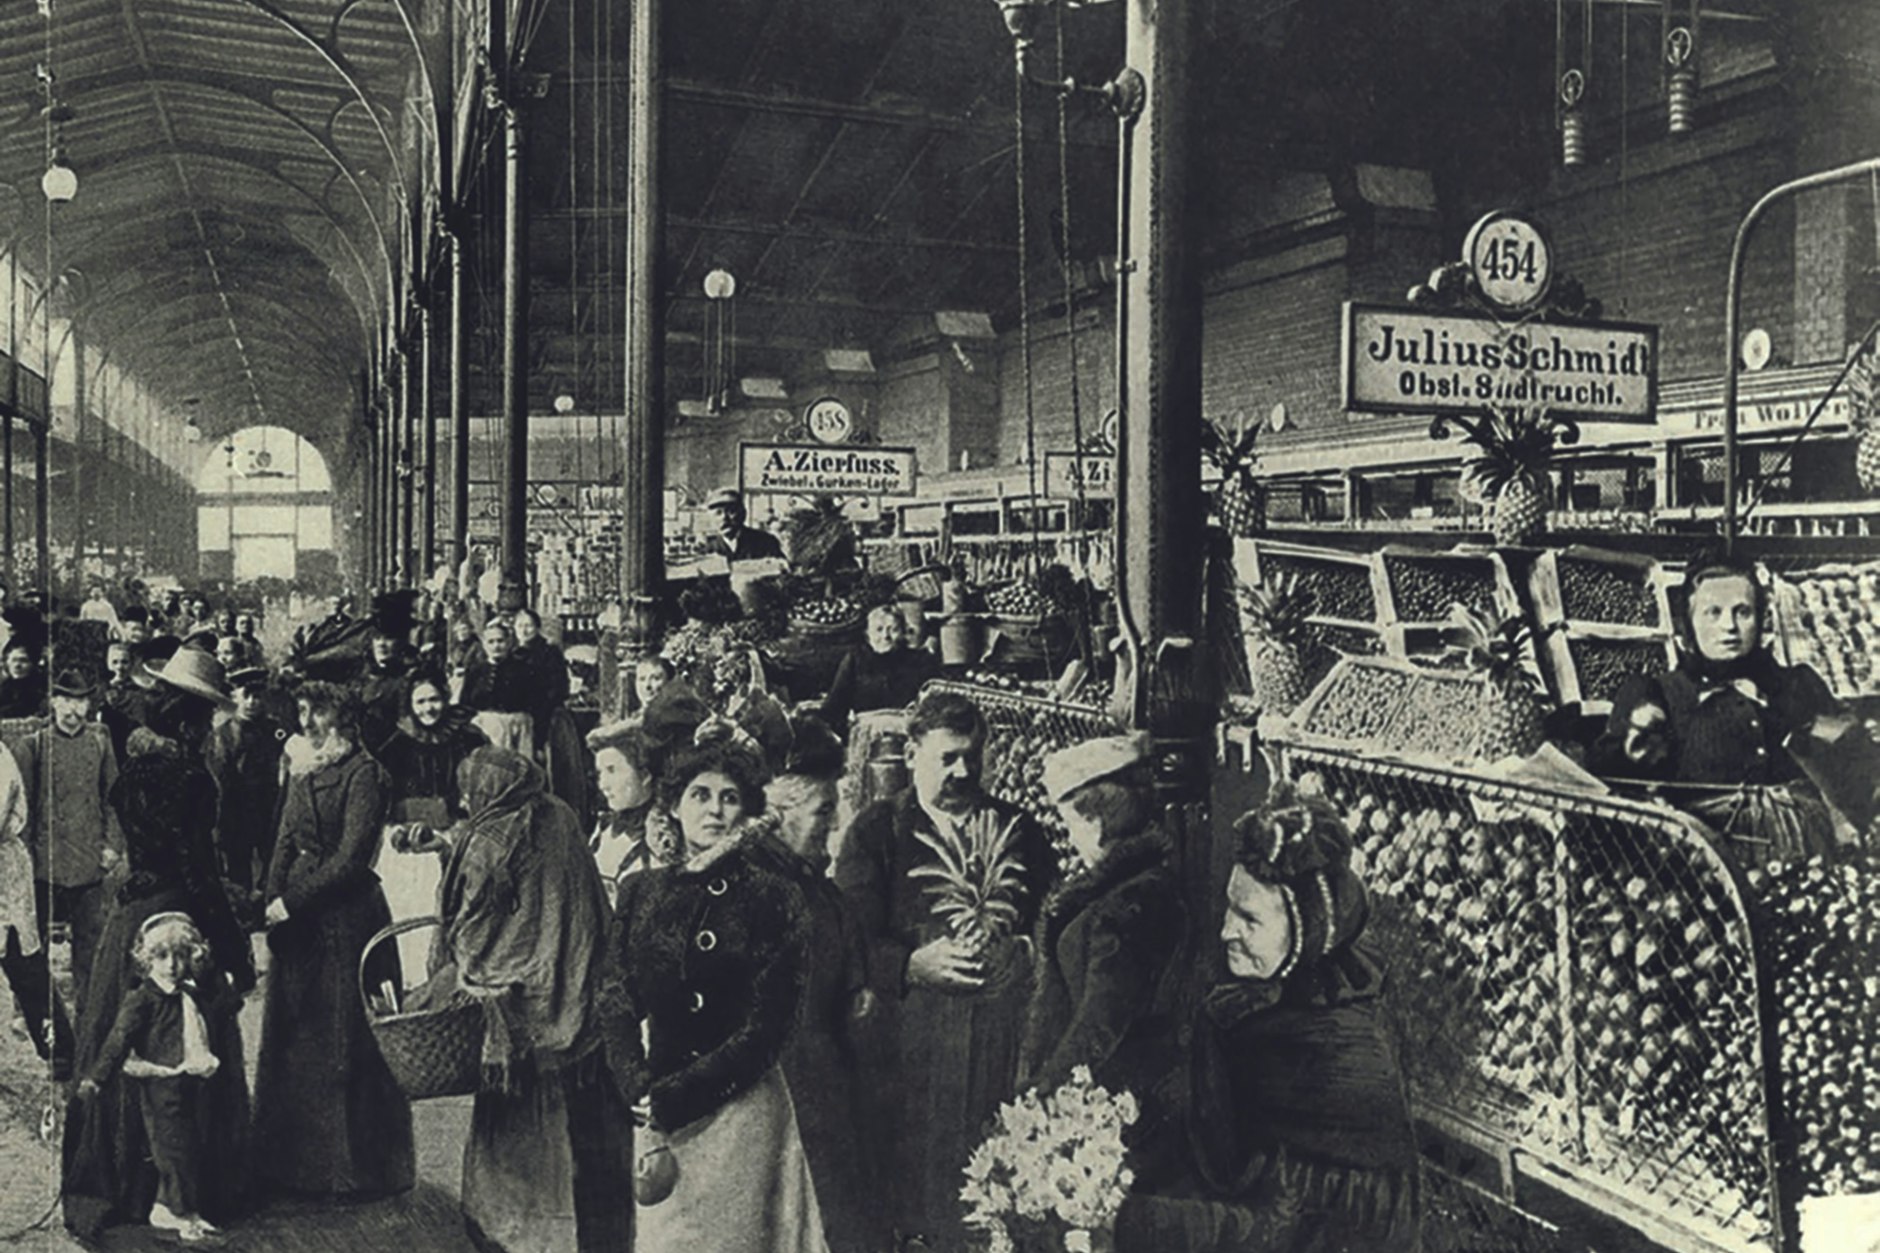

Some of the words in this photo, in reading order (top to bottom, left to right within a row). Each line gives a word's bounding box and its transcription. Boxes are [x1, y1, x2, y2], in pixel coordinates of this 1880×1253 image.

[1481, 239, 1537, 283] 454
[1368, 326, 1499, 368] Julius
[1502, 334, 1649, 376] Schmidt
[1399, 371, 1470, 398] Obst.
